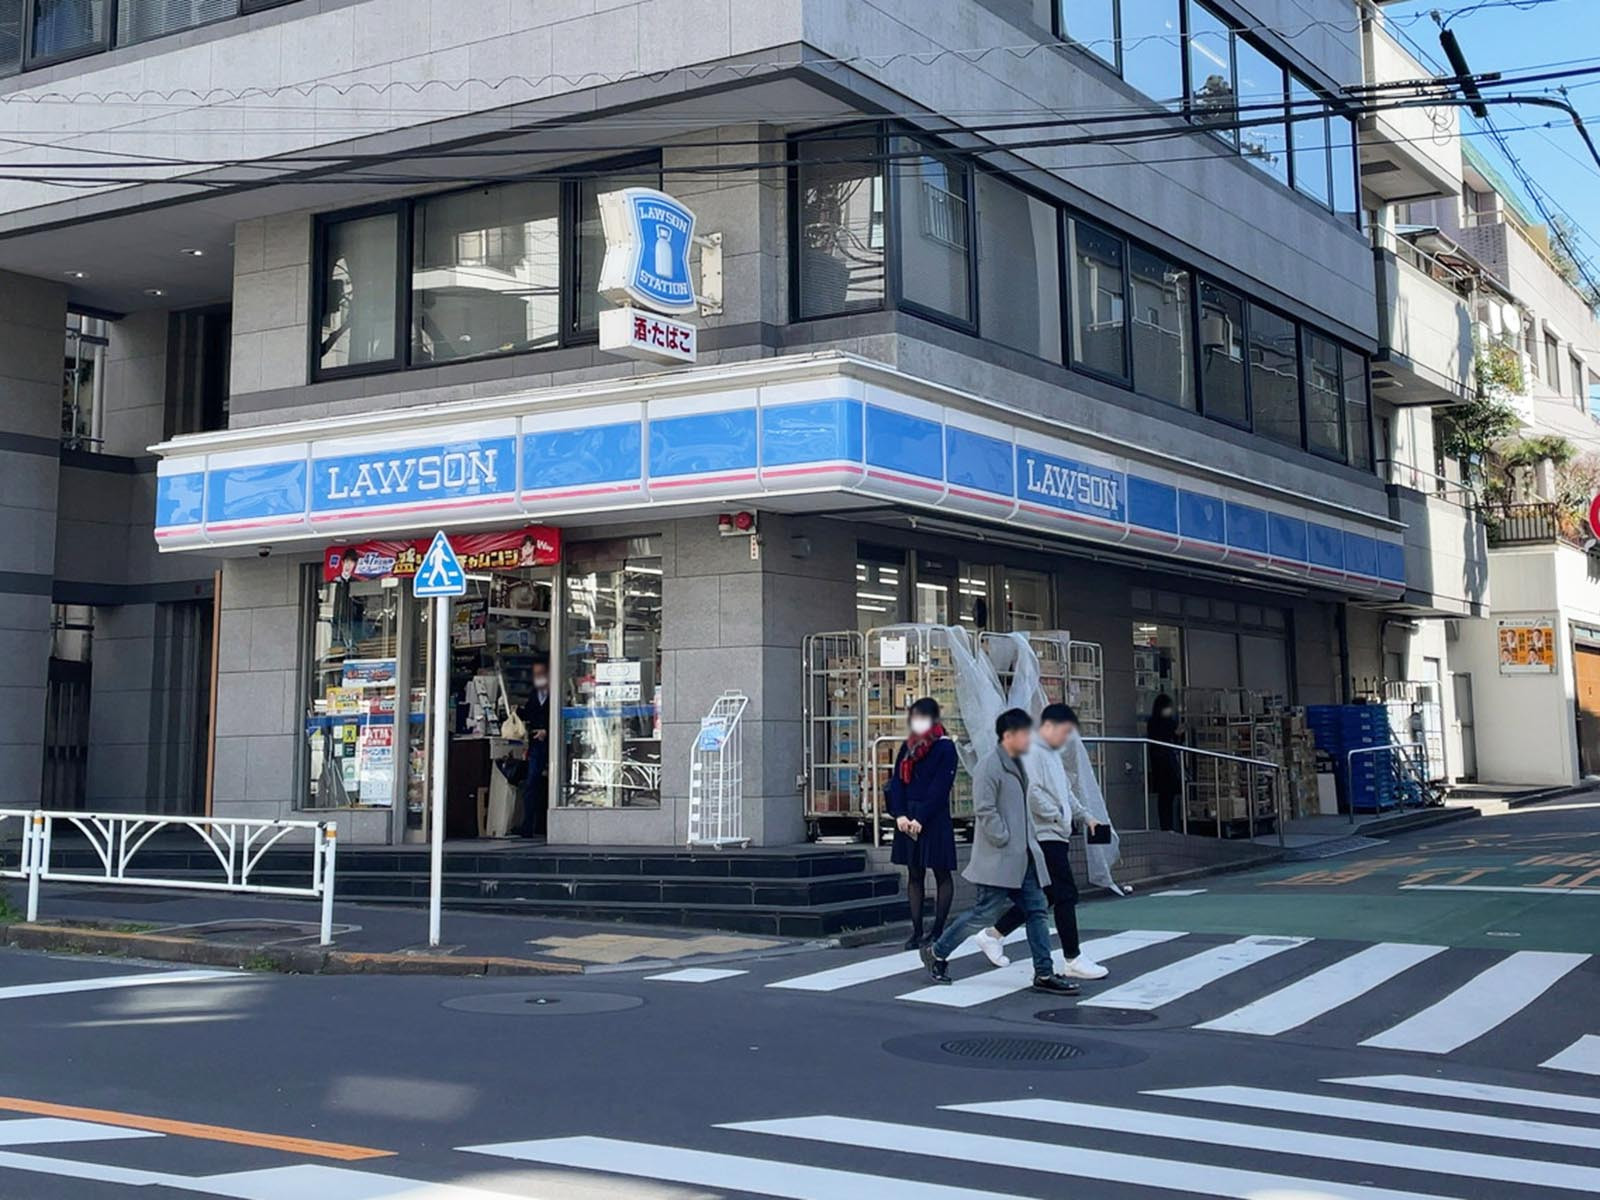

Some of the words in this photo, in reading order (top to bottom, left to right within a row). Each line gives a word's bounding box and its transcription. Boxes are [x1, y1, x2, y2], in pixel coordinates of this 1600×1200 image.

[639, 207, 688, 234] LAWSON
[640, 269, 689, 296] STATION
[634, 316, 691, 353] 酒・たばこ
[328, 449, 497, 500] LAWSON
[1026, 459, 1118, 511] LAWSON
